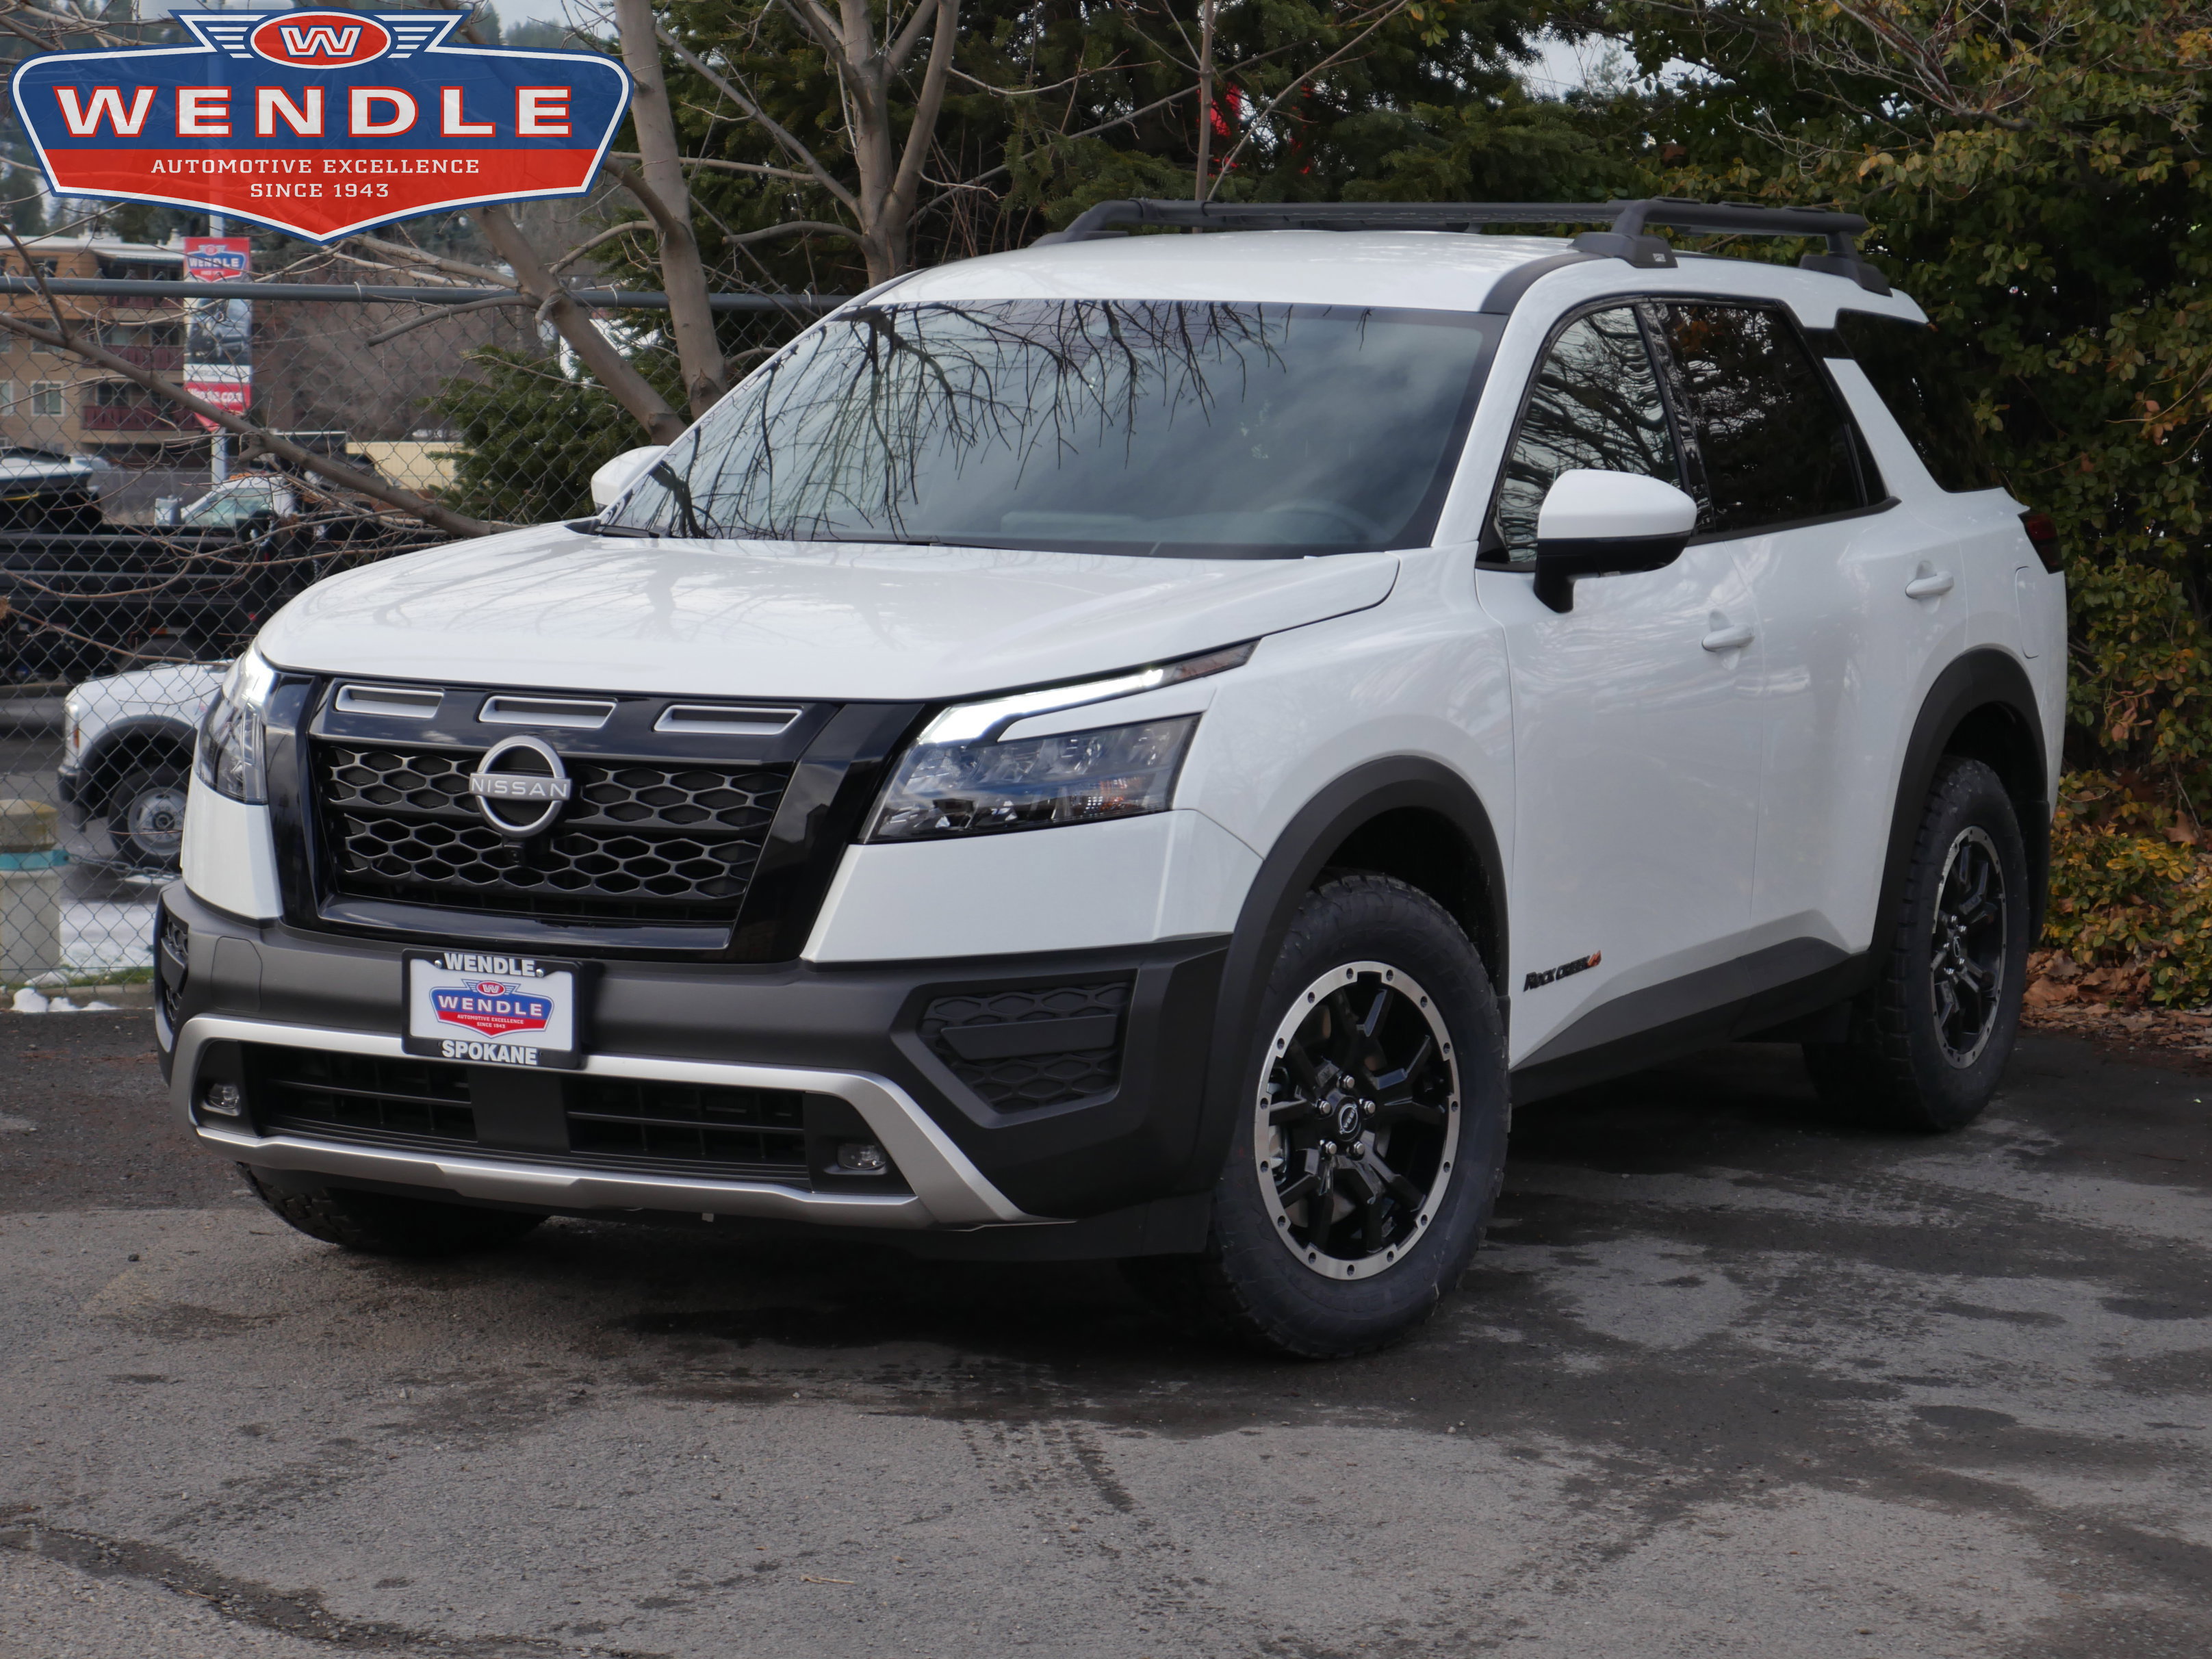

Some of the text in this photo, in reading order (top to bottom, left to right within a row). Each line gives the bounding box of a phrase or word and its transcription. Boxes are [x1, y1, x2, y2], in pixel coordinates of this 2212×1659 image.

[188, 257, 240, 268] WENDLE
[472, 777, 567, 797] NISSAN
[443, 953, 535, 977] WENDLE
[438, 995, 542, 1016] WENDLE
[457, 1014, 524, 1025] AUTOMOTIVE EXCELLENCE
[441, 1040, 537, 1065] SPOKANE
